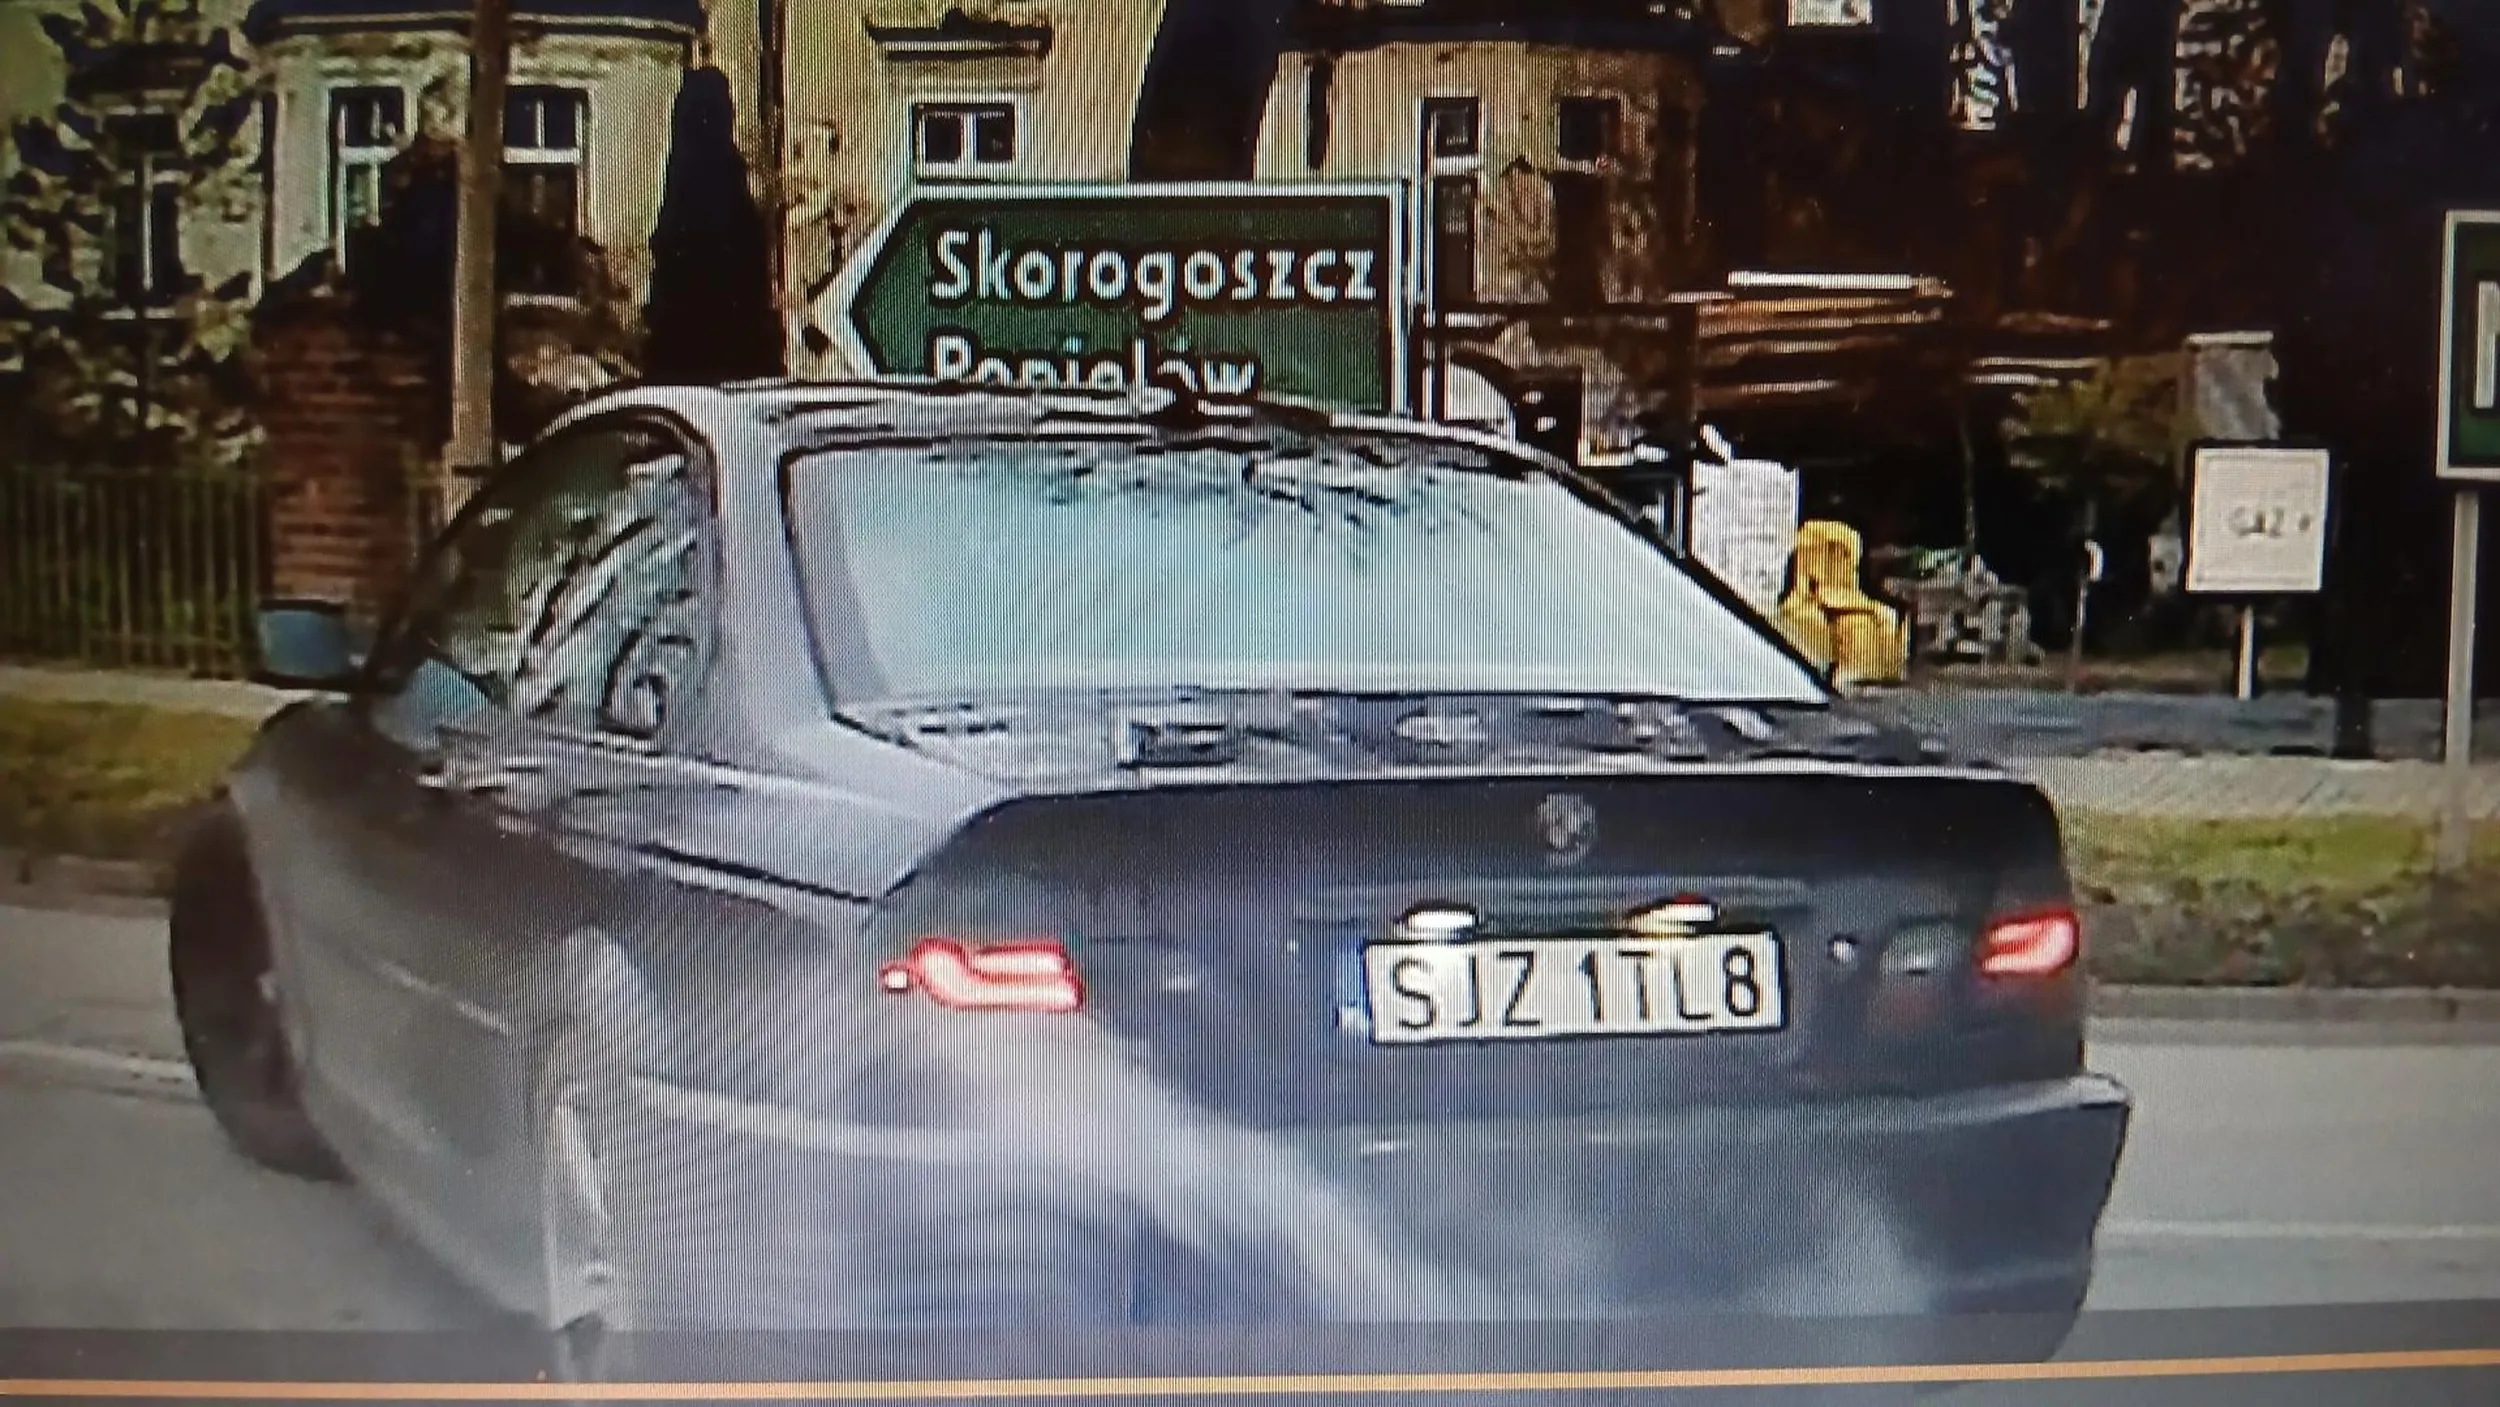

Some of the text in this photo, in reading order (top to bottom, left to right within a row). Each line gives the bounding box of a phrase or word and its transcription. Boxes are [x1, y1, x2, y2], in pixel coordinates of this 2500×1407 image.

[930, 227, 1376, 320] Skorogoszcz
[1391, 945, 1762, 1031] SJZ 1TL8
